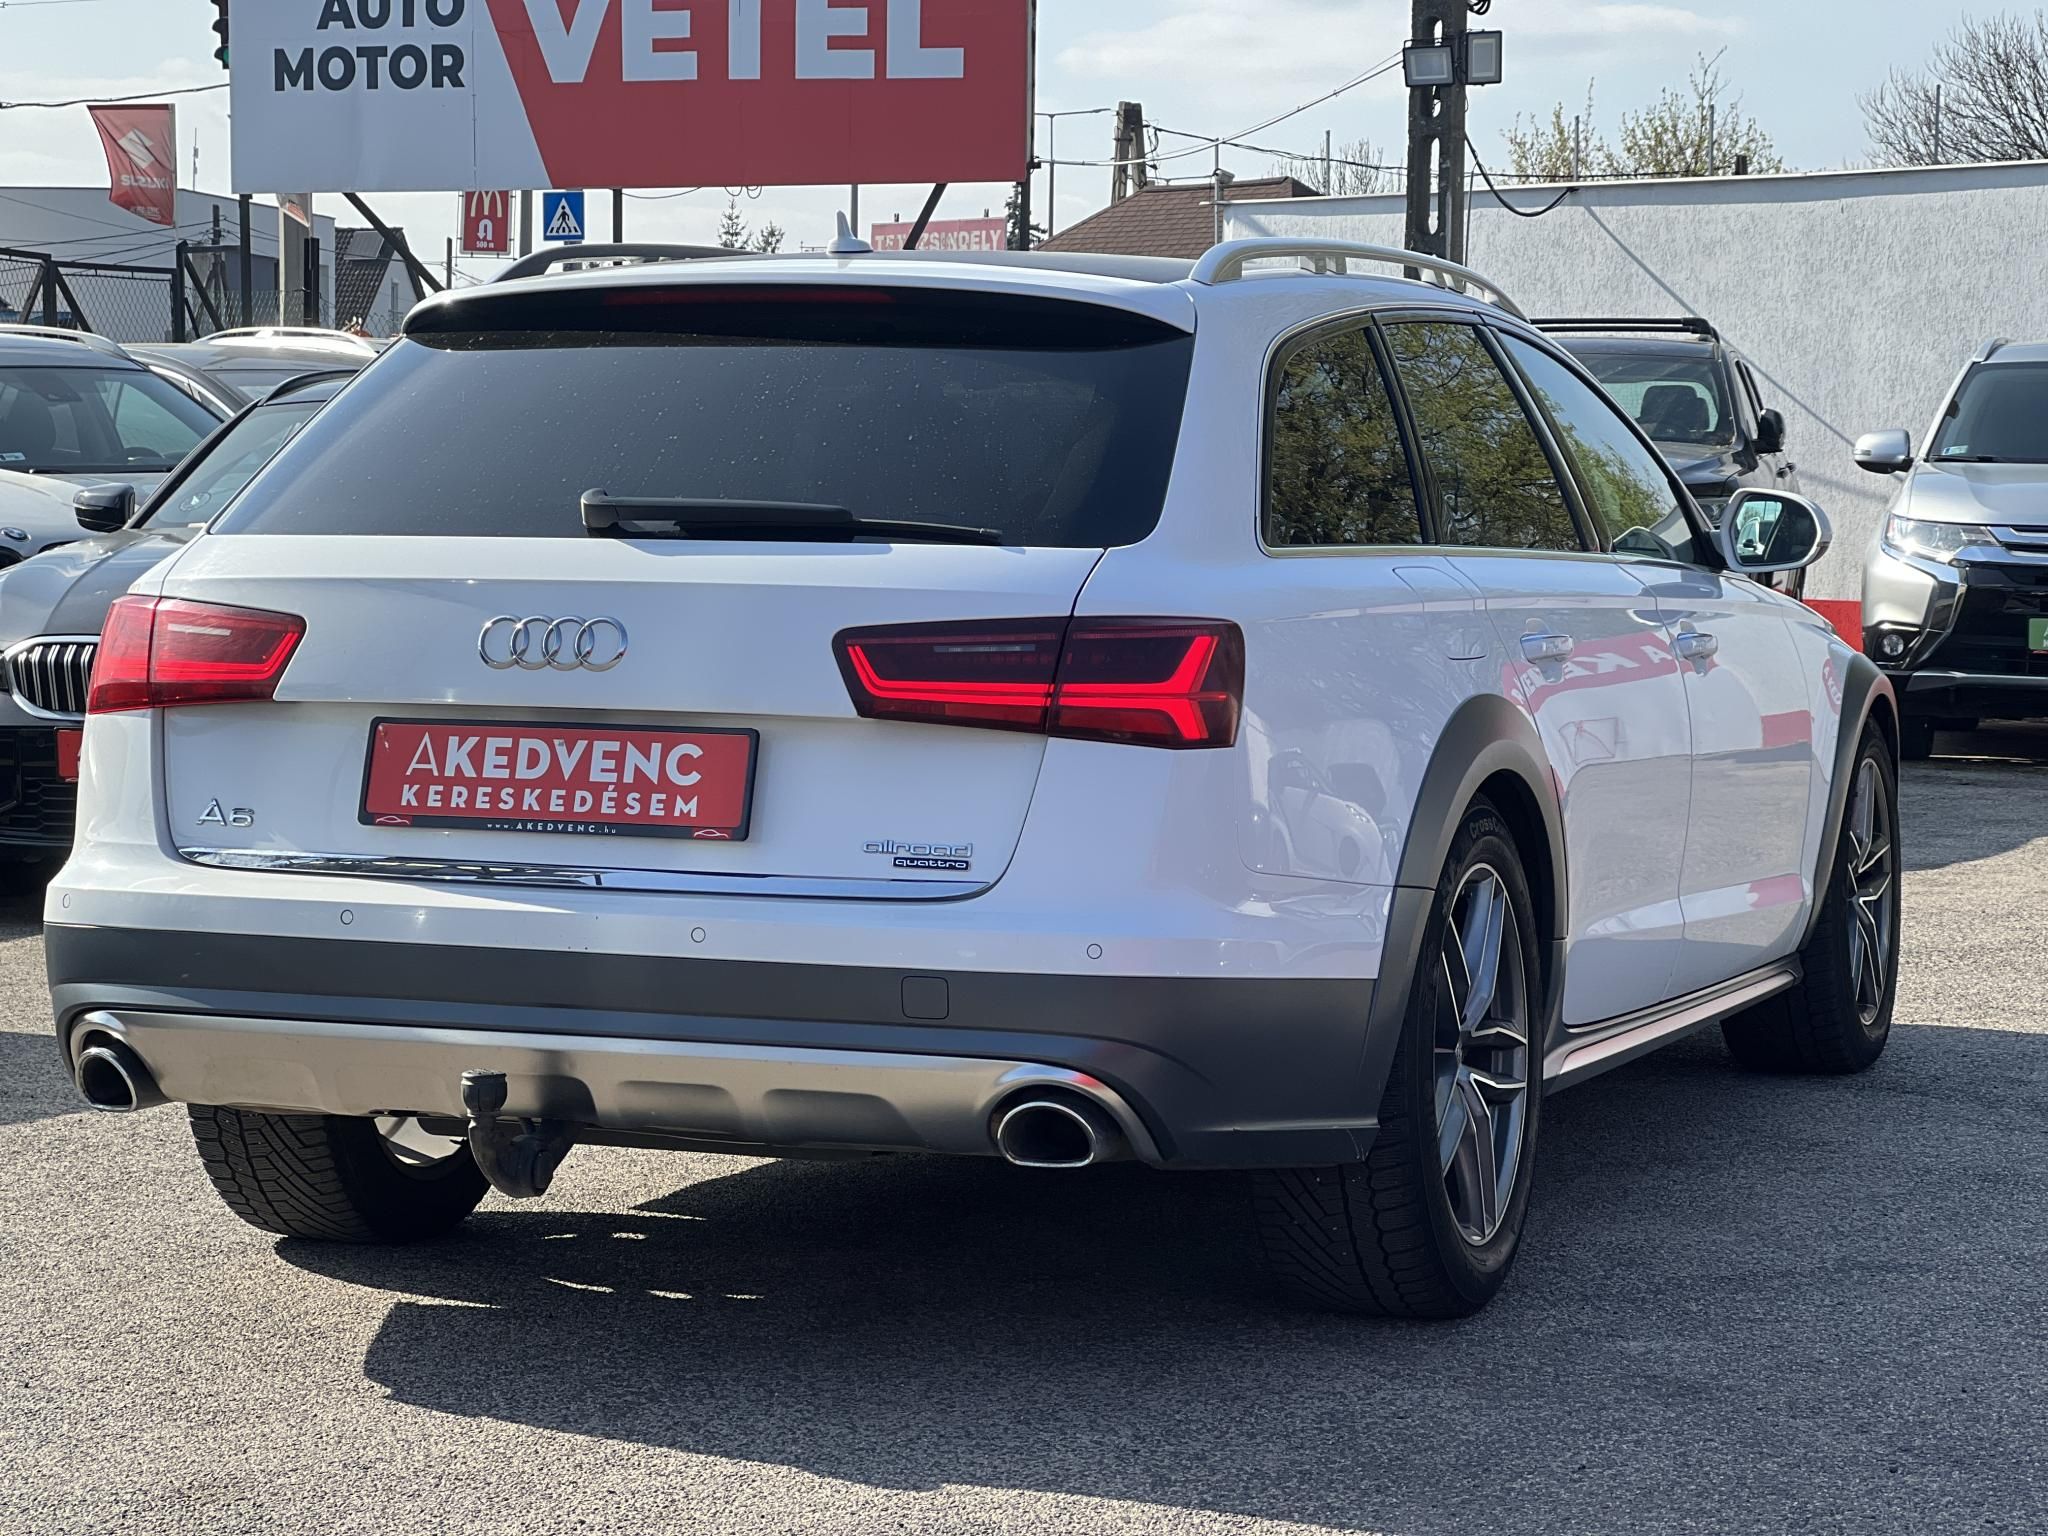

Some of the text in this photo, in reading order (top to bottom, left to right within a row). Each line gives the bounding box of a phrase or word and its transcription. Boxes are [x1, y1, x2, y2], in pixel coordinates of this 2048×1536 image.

[273, 43, 466, 92] MOTOR
[405, 731, 704, 786] AKEDVENC
[196, 798, 255, 828] A6
[400, 784, 698, 818] KERESKEDÉSEM
[487, 821, 617, 835] www.AKEDVENC.hu
[862, 839, 973, 859] allroad
[894, 857, 968, 869] quattro
